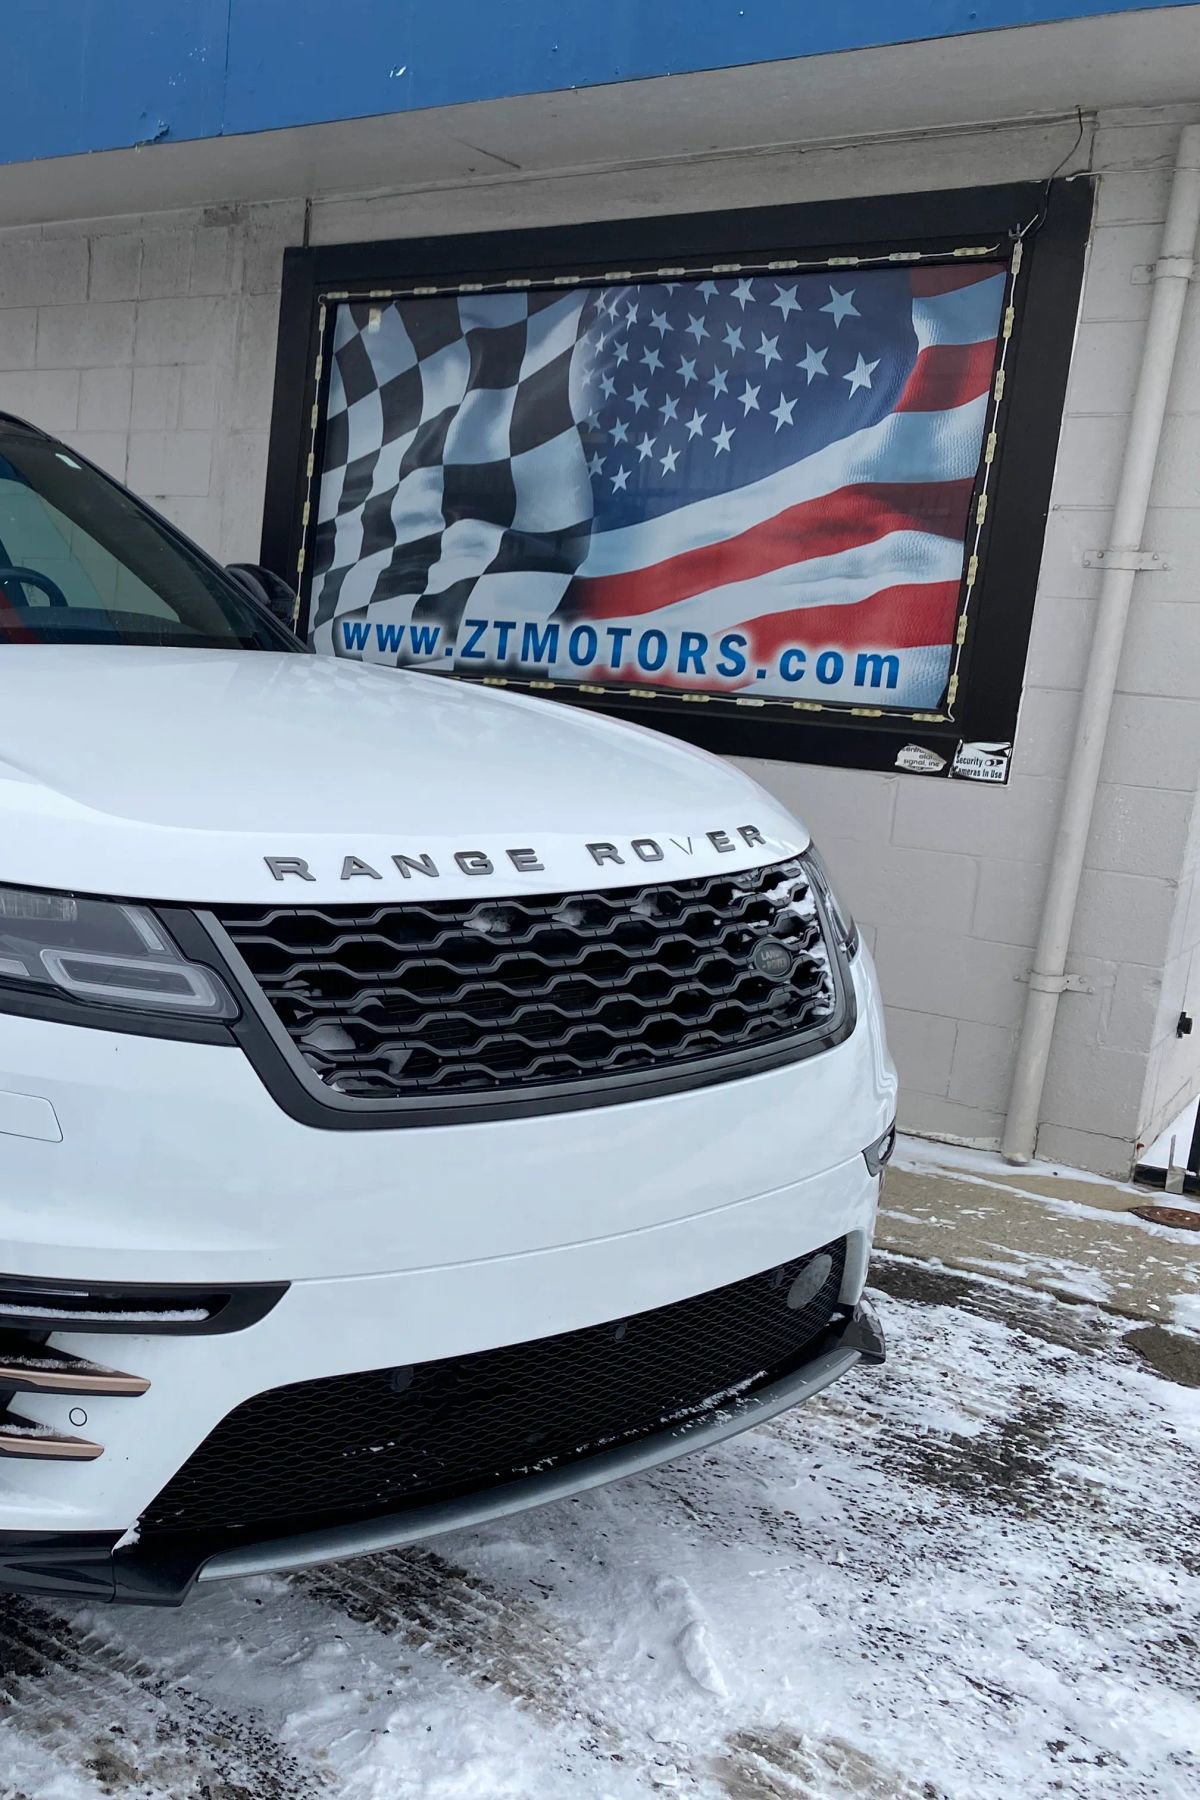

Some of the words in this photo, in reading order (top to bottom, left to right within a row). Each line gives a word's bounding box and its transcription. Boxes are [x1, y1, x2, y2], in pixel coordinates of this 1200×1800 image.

[341, 617, 901, 690] www.ZTMOTORS.com
[956, 755, 983, 767] Security
[990, 769, 1002, 779] Use
[263, 848, 545, 881] RANGE
[585, 824, 767, 867] ROVER
